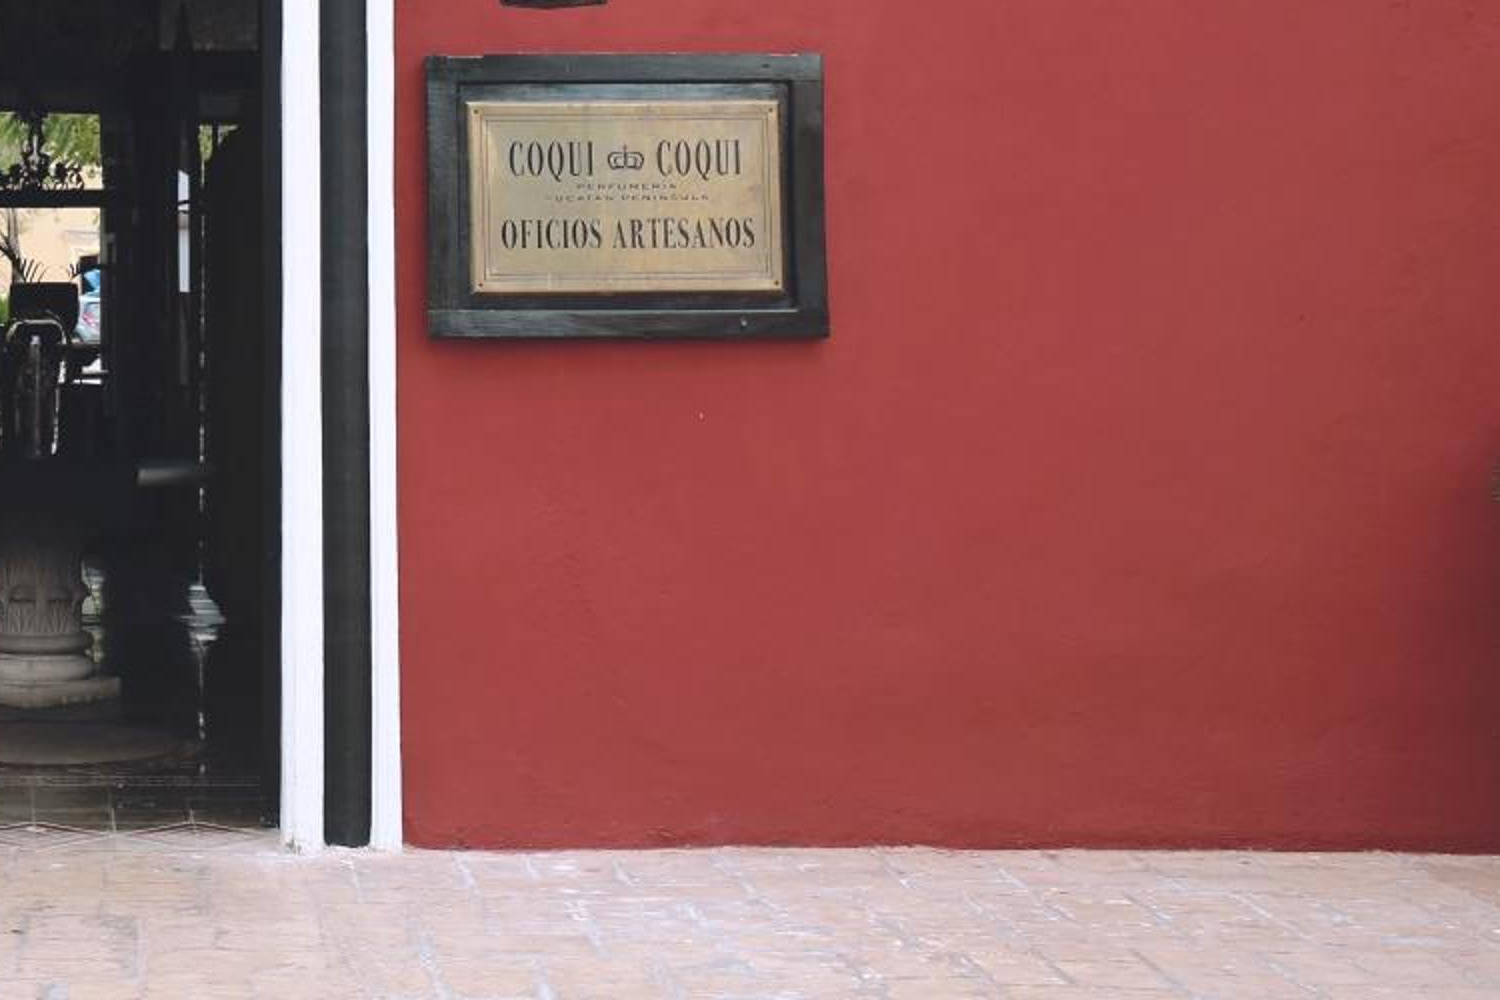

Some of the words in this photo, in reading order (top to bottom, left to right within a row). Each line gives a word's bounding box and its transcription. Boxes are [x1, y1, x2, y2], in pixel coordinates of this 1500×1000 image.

[509, 139, 594, 181] COQUI
[657, 138, 741, 181] COQUI
[501, 217, 602, 249] OFICIOS
[612, 217, 756, 249] ARTESANOS
